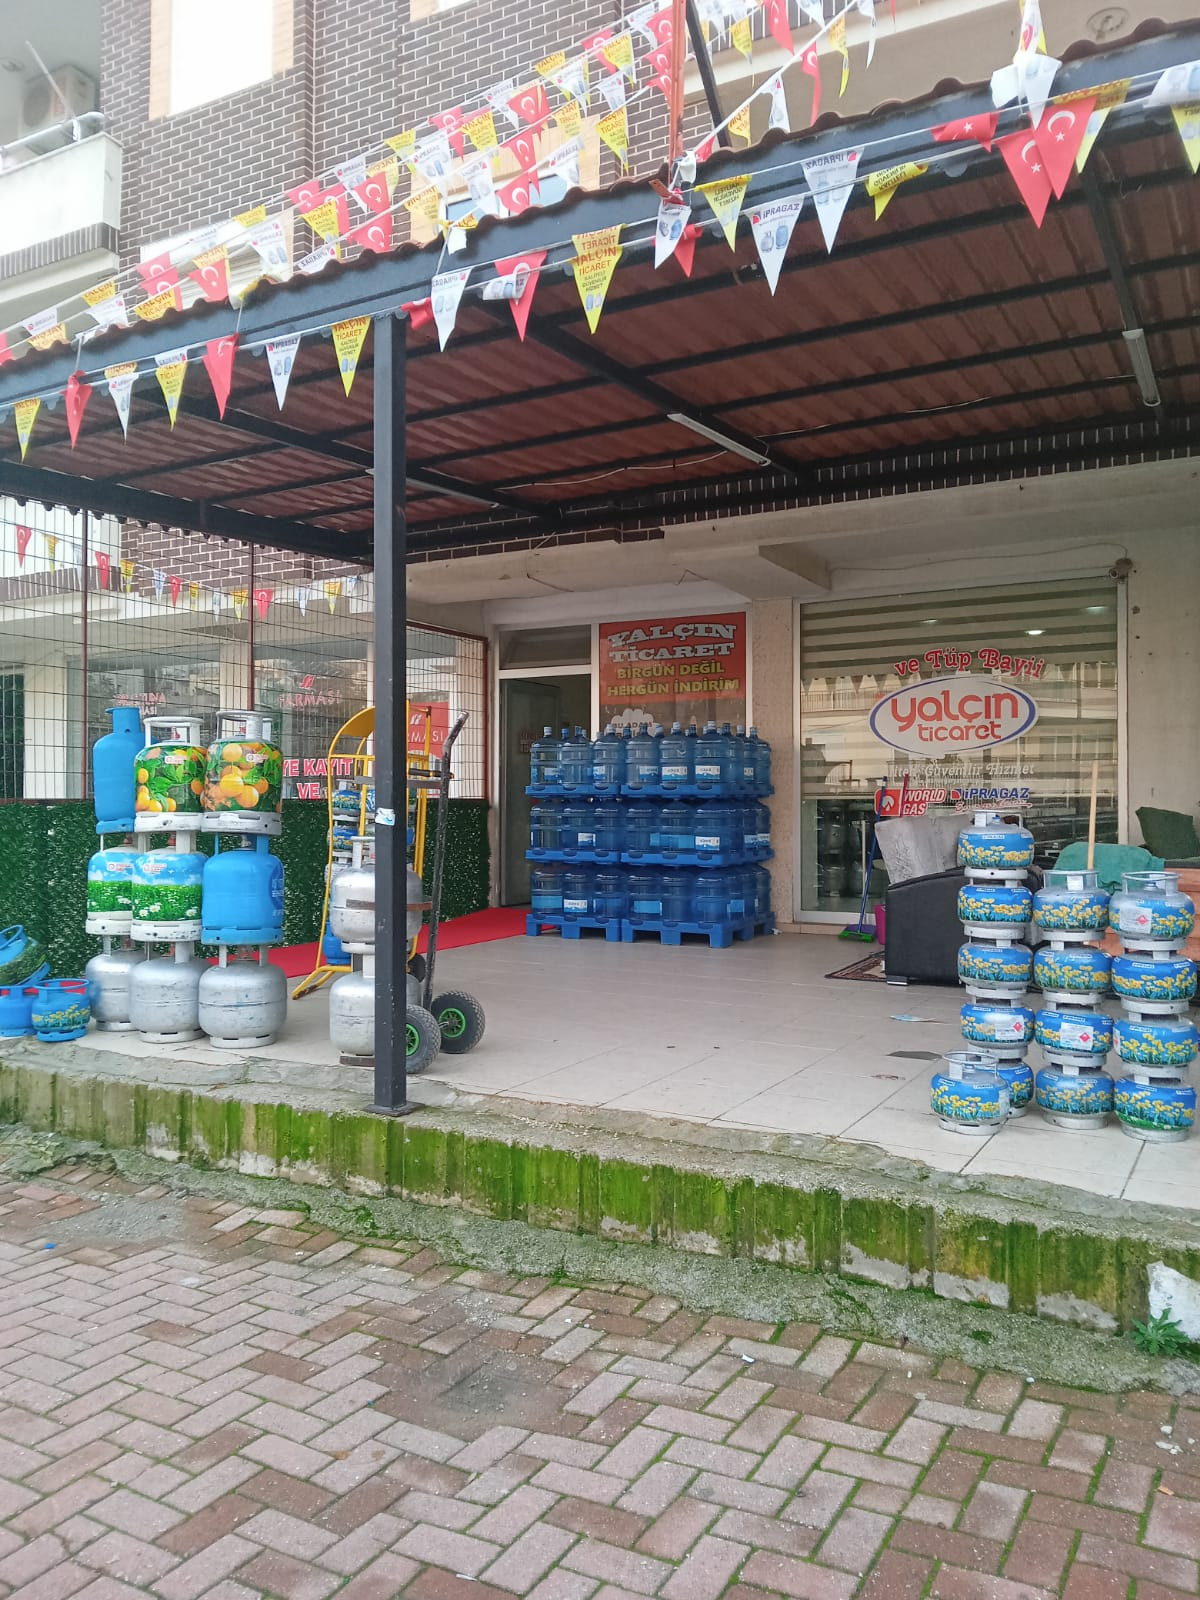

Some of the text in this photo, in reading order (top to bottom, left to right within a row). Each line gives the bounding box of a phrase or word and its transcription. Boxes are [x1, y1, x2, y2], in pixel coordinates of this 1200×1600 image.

[608, 623, 737, 648] YALÇIN
[609, 642, 735, 662] TİCARET
[617, 660, 725, 679] BİRGÜN DEĞİL
[895, 647, 1046, 678] ve Tüp Bayii
[607, 677, 739, 697] HERGÜN İNDİRİM
[891, 689, 1019, 733] yalçın
[917, 720, 1002, 742] ticaret
[296, 783, 321, 800] VE
[904, 789, 946, 802] WORLD
[902, 803, 927, 816] GAS
